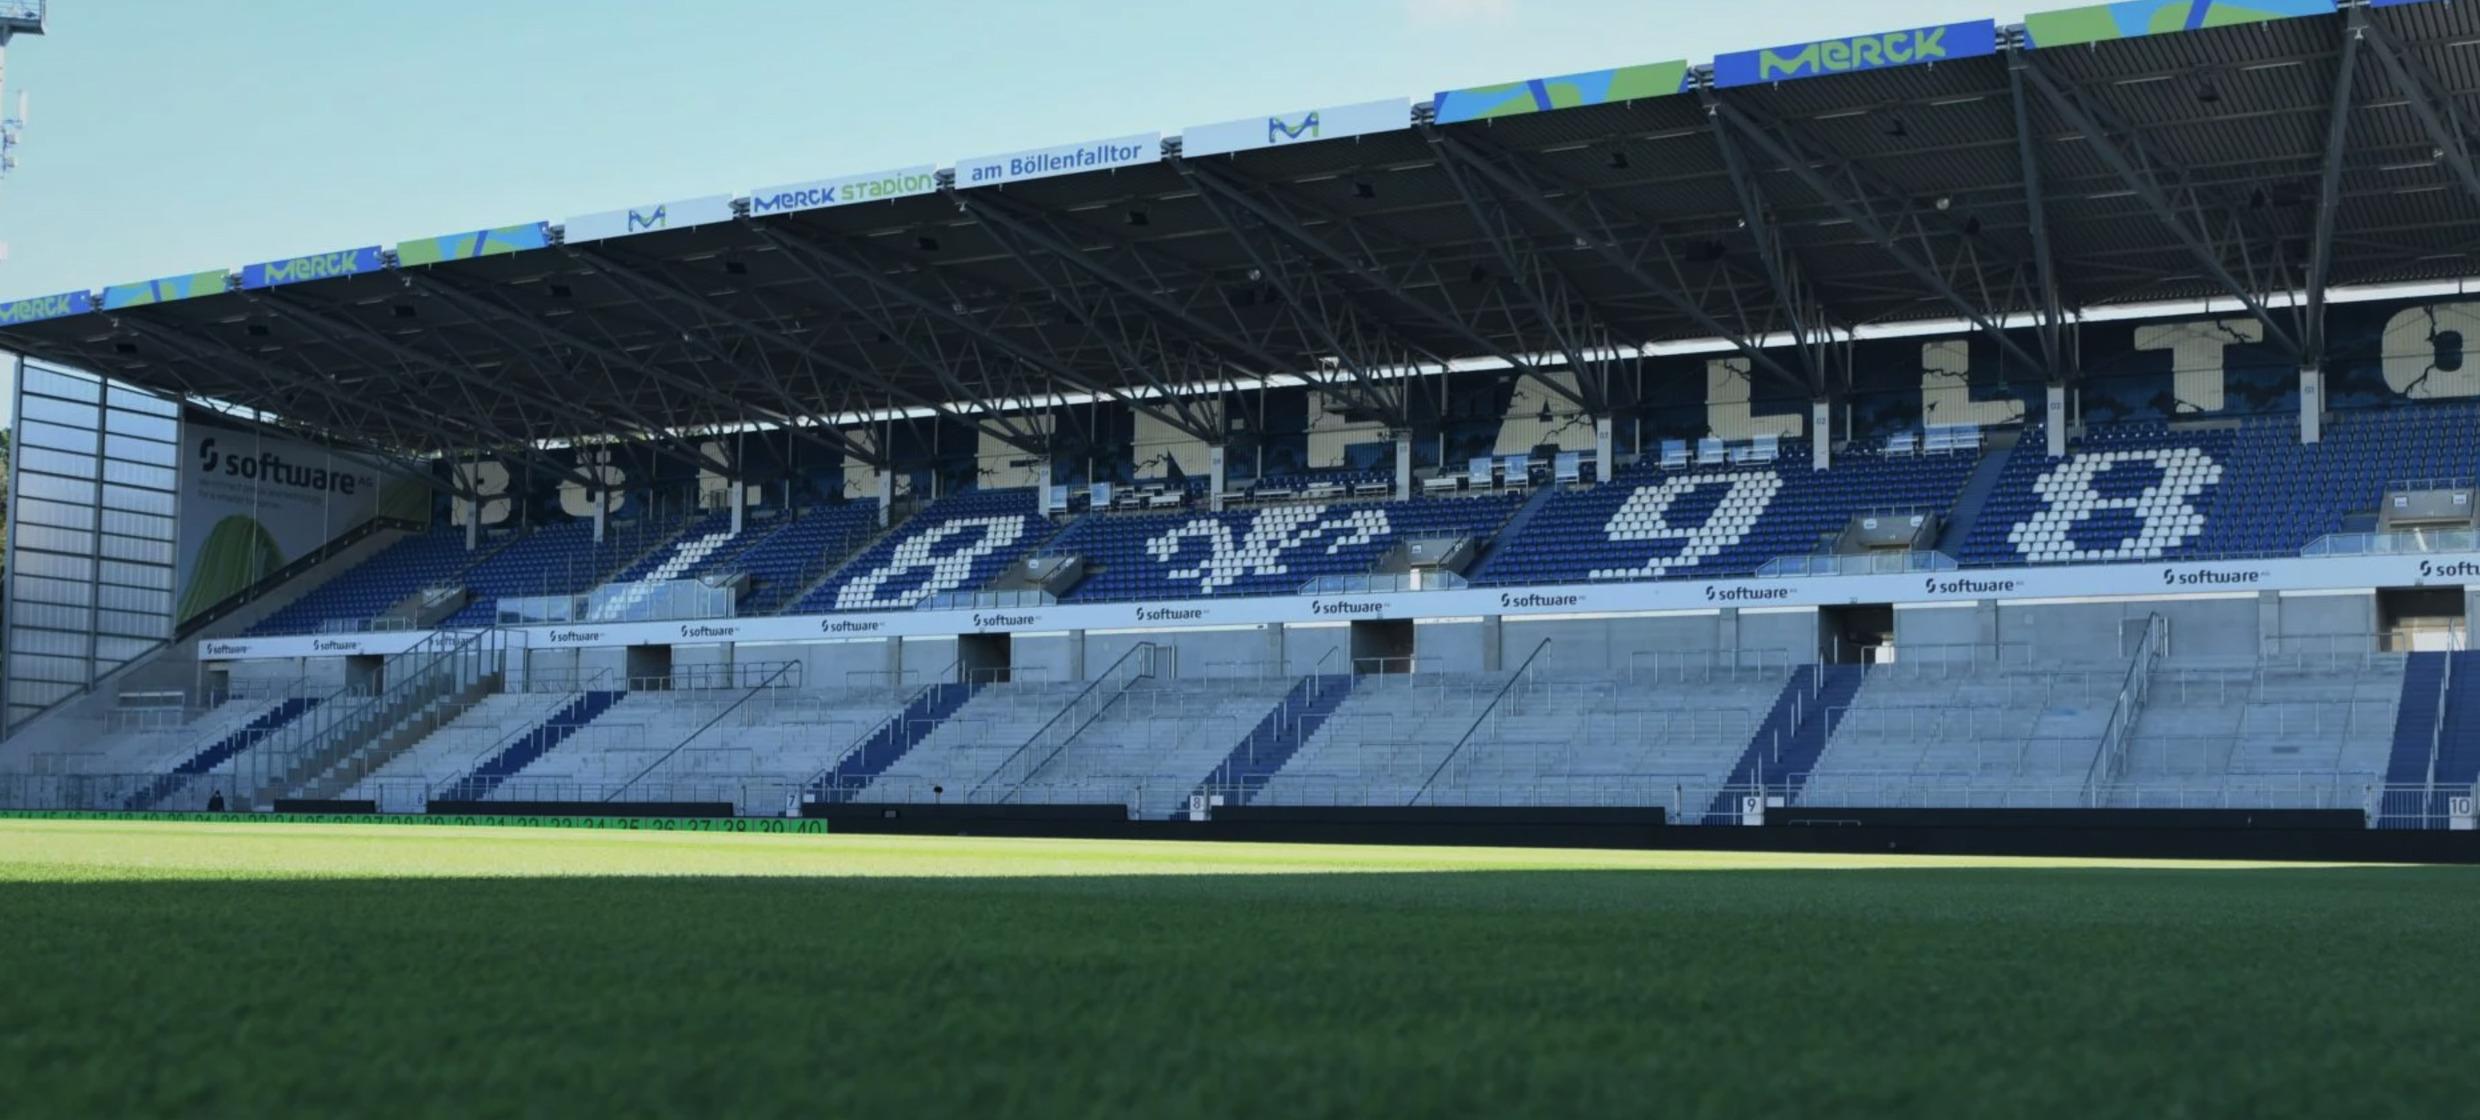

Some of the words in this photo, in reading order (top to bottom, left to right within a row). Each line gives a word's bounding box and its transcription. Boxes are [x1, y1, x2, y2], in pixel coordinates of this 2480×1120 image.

[1759, 26, 1946, 80] MERCK
[971, 161, 1002, 182] am
[1011, 143, 1142, 176] Böllenfalltor
[264, 250, 358, 287] MERCK
[225, 452, 354, 495] software
[1588, 470, 1783, 578] 9
[2007, 447, 2223, 562] 8
[2178, 568, 2260, 584] software
[2436, 561, 2480, 576] soft
[1939, 578, 2014, 593] software
[1512, 594, 1577, 607] software
[1719, 586, 1788, 601] software
[1146, 607, 1202, 621] software
[1323, 601, 1383, 613] software
[829, 619, 879, 632] software
[983, 613, 1035, 626] software
[688, 625, 734, 637] software
[1193, 796, 1201, 809] 8
[1747, 798, 1757, 812] 9
[2451, 799, 2470, 814] 10
